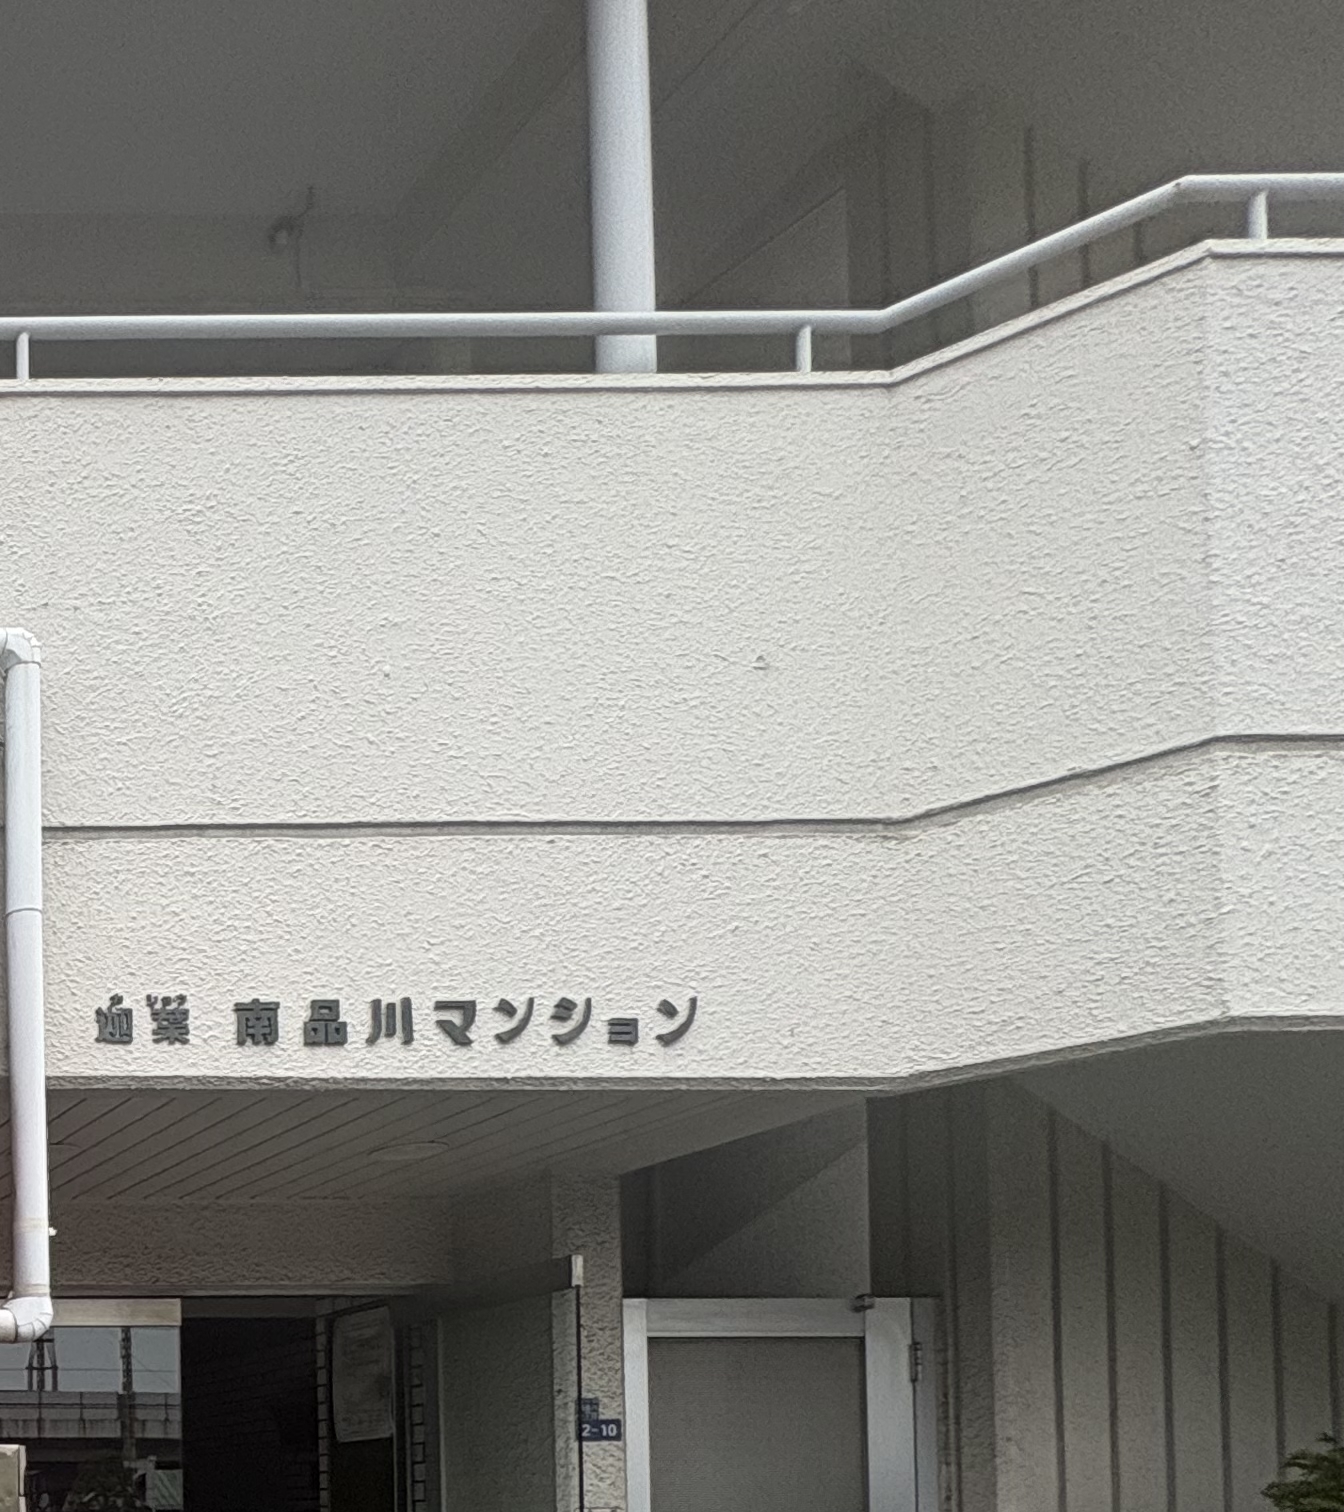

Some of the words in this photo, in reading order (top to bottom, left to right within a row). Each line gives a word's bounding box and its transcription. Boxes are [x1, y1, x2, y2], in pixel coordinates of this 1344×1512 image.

[232, 996, 698, 1048] 南品川マンション
[581, 1423, 618, 1437] 2-10
